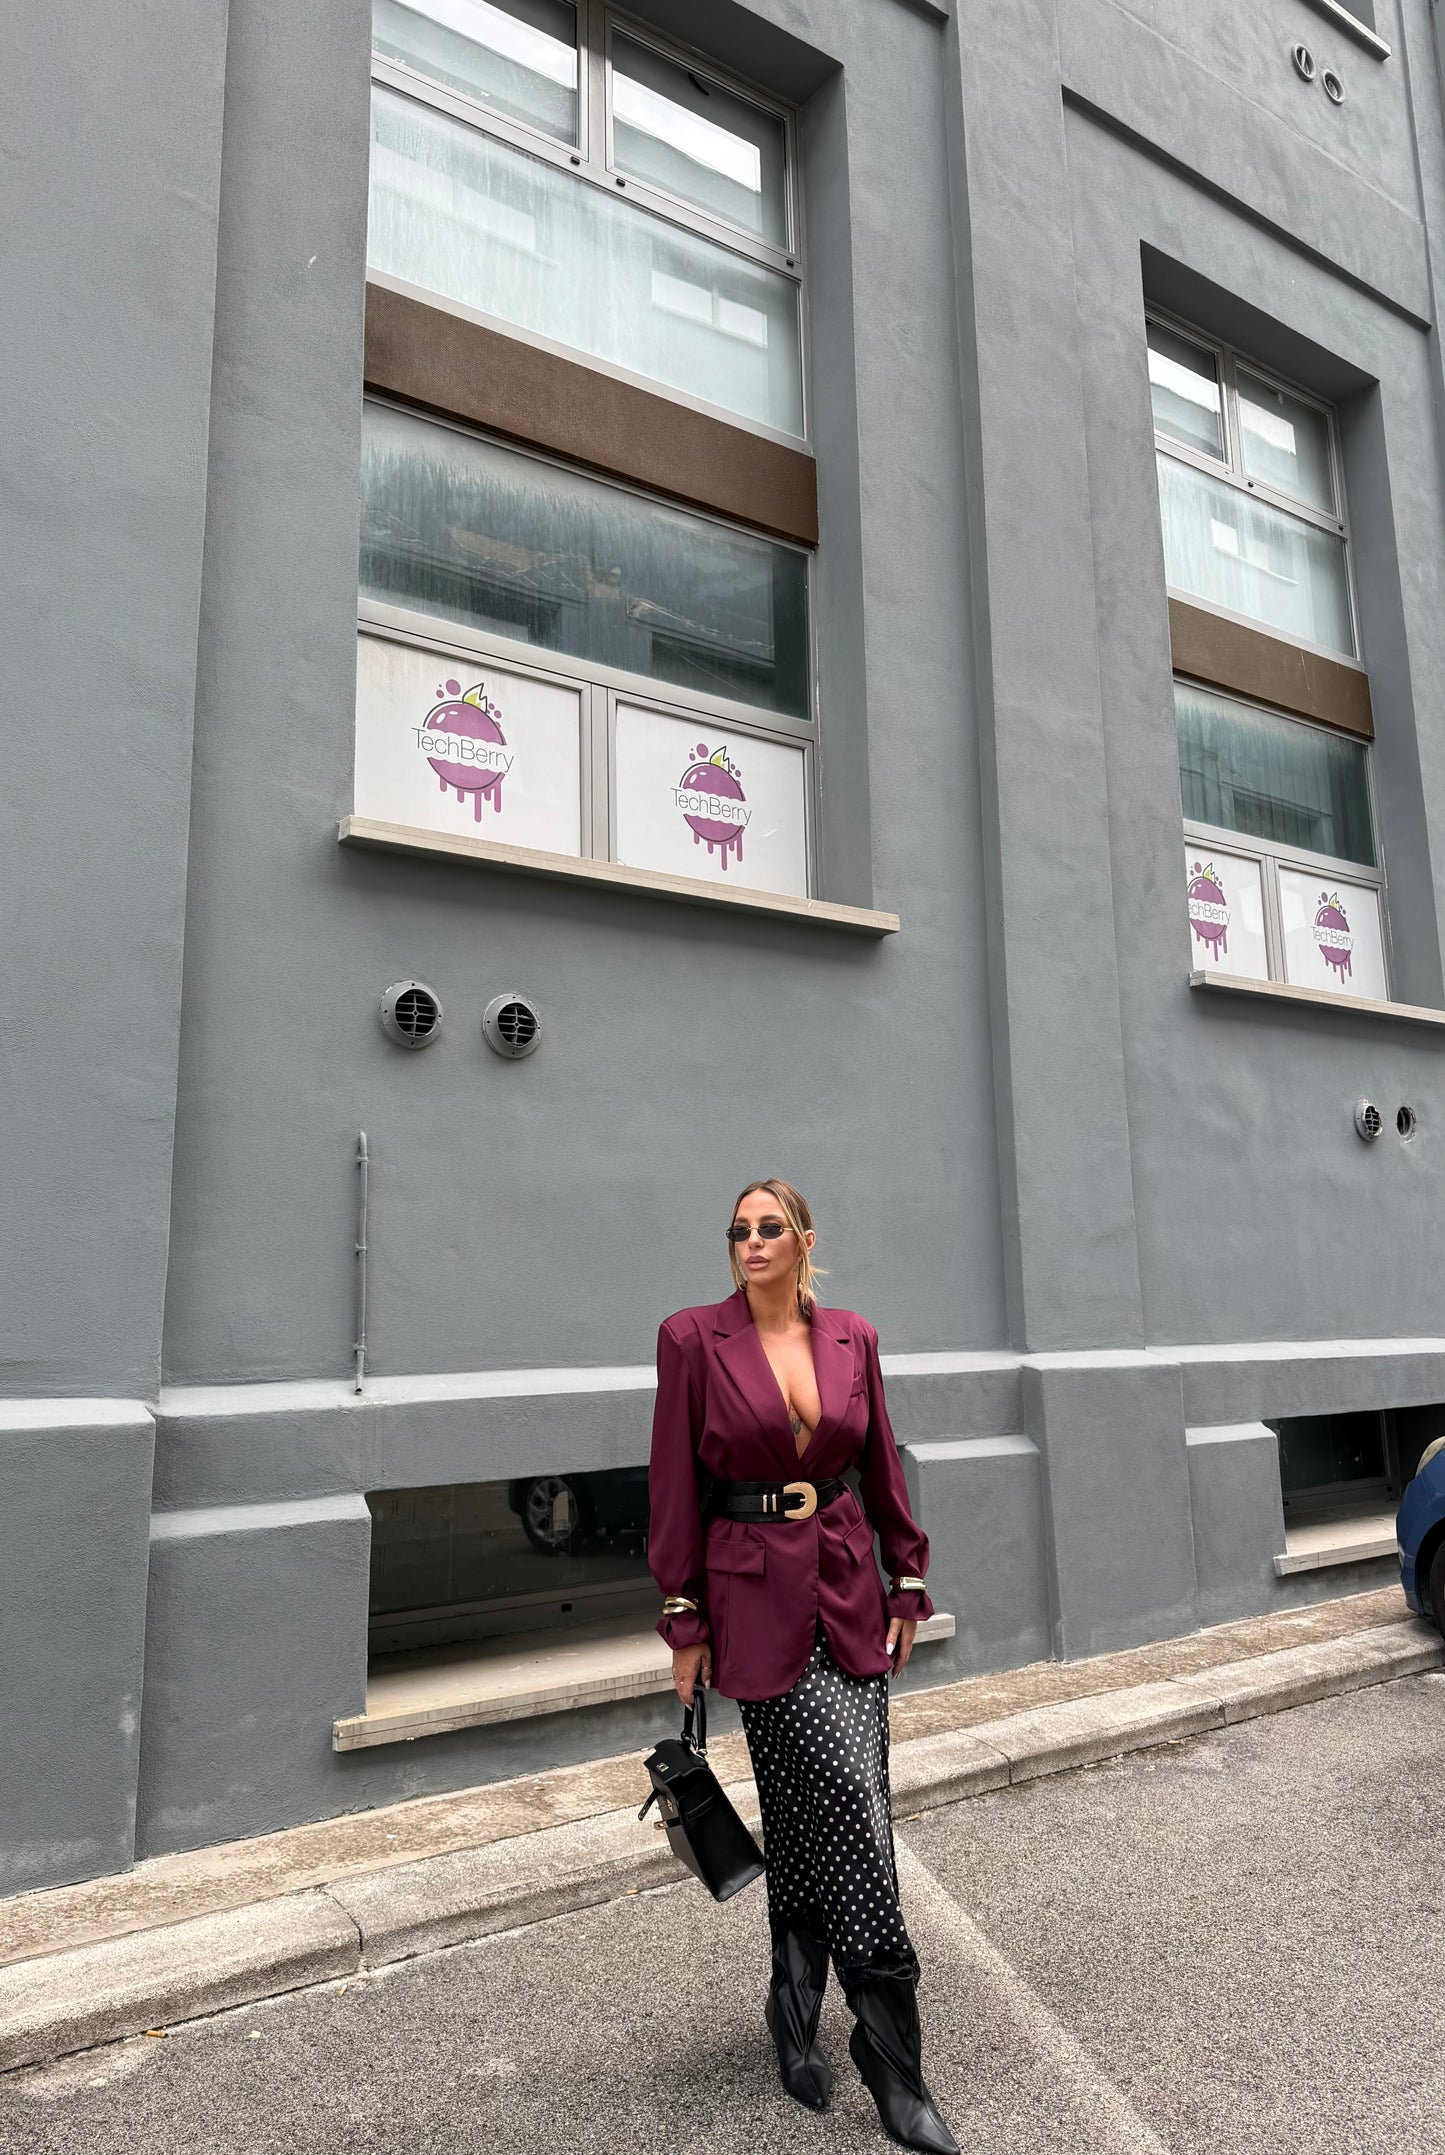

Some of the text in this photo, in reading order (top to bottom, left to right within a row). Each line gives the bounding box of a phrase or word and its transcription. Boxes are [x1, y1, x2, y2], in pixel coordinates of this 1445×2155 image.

[411, 727, 514, 772] TechBerry
[670, 787, 752, 826] TechBerry
[1188, 901, 1231, 925] echBerry
[1310, 925, 1354, 951] TechBerry
